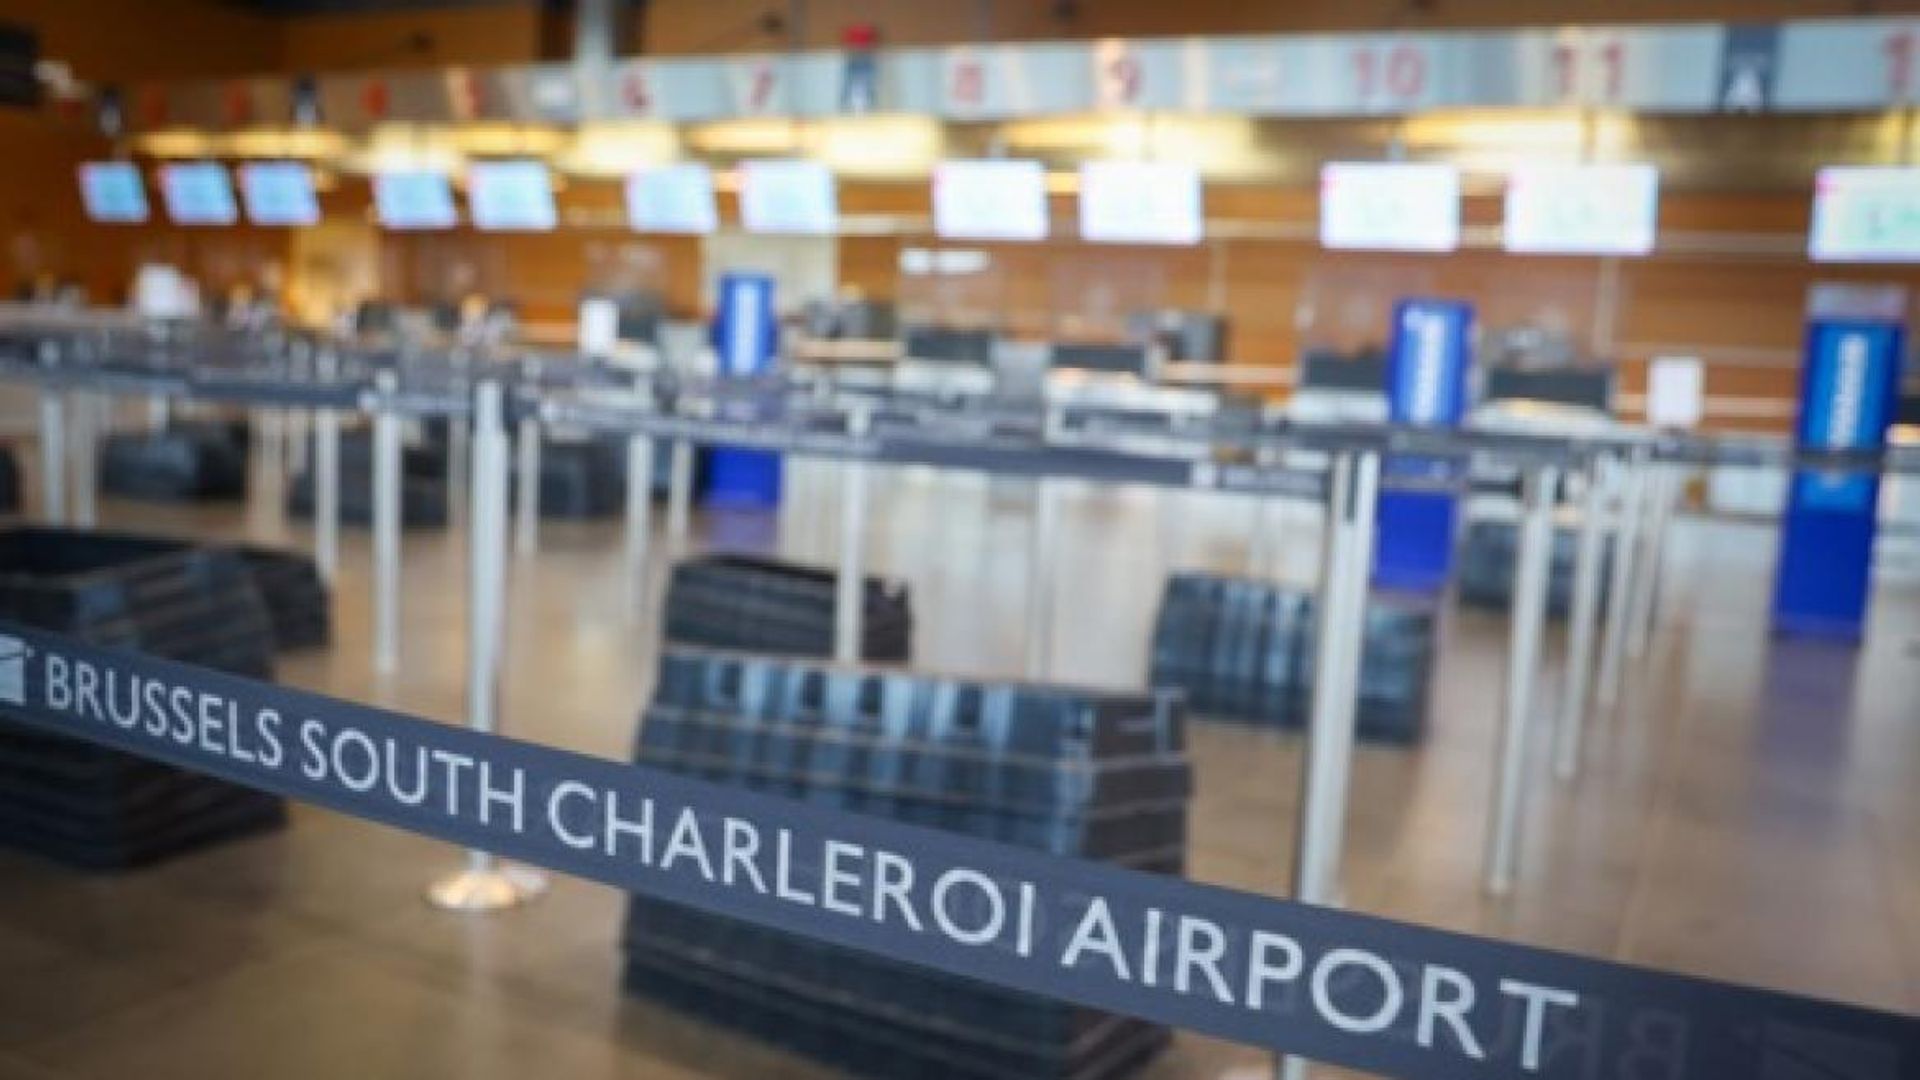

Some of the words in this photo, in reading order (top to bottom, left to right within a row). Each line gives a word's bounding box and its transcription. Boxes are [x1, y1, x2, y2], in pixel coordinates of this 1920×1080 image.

[1350, 44, 1427, 98] 10
[1552, 46, 1628, 94] 11
[44, 653, 284, 769] BRUSSELS
[301, 719, 525, 834] SOUTH
[547, 779, 1037, 958] CHARLEROI
[1060, 895, 1579, 1071] AIRPORT
